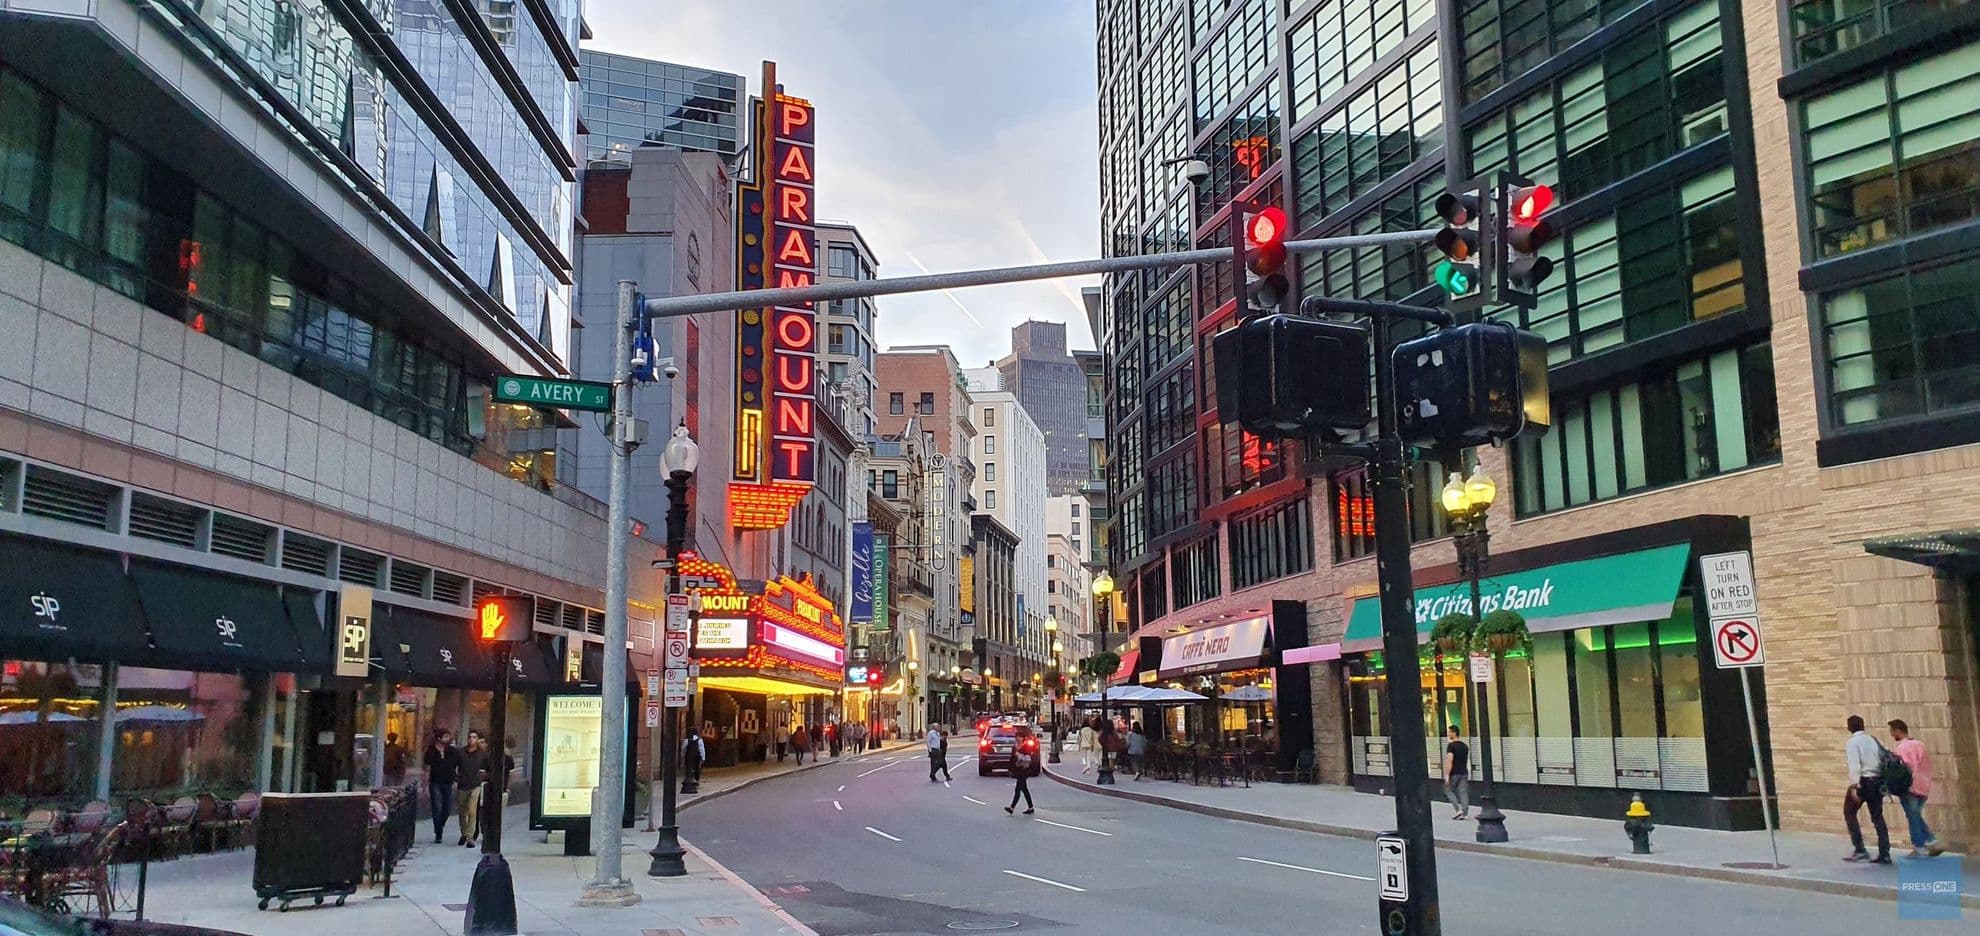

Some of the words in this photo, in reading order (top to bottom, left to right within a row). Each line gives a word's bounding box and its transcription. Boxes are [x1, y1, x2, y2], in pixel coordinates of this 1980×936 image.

[530, 382, 584, 402] AVERY
[594, 395, 605, 404] ST
[934, 479, 944, 559] MODERN
[852, 543, 873, 603] Giselle
[874, 559, 884, 591] OPERA
[1715, 560, 1736, 572] LEFT
[1716, 572, 1740, 584] TURN
[1501, 578, 1555, 611] Bank
[1710, 587, 1726, 600] ON
[1729, 584, 1751, 598] RED
[874, 592, 883, 625] HOUSE
[1711, 600, 1734, 612] AFTER
[1735, 598, 1754, 610] STOP
[1205, 637, 1230, 656] NERO
[552, 700, 596, 709] WELCOME
